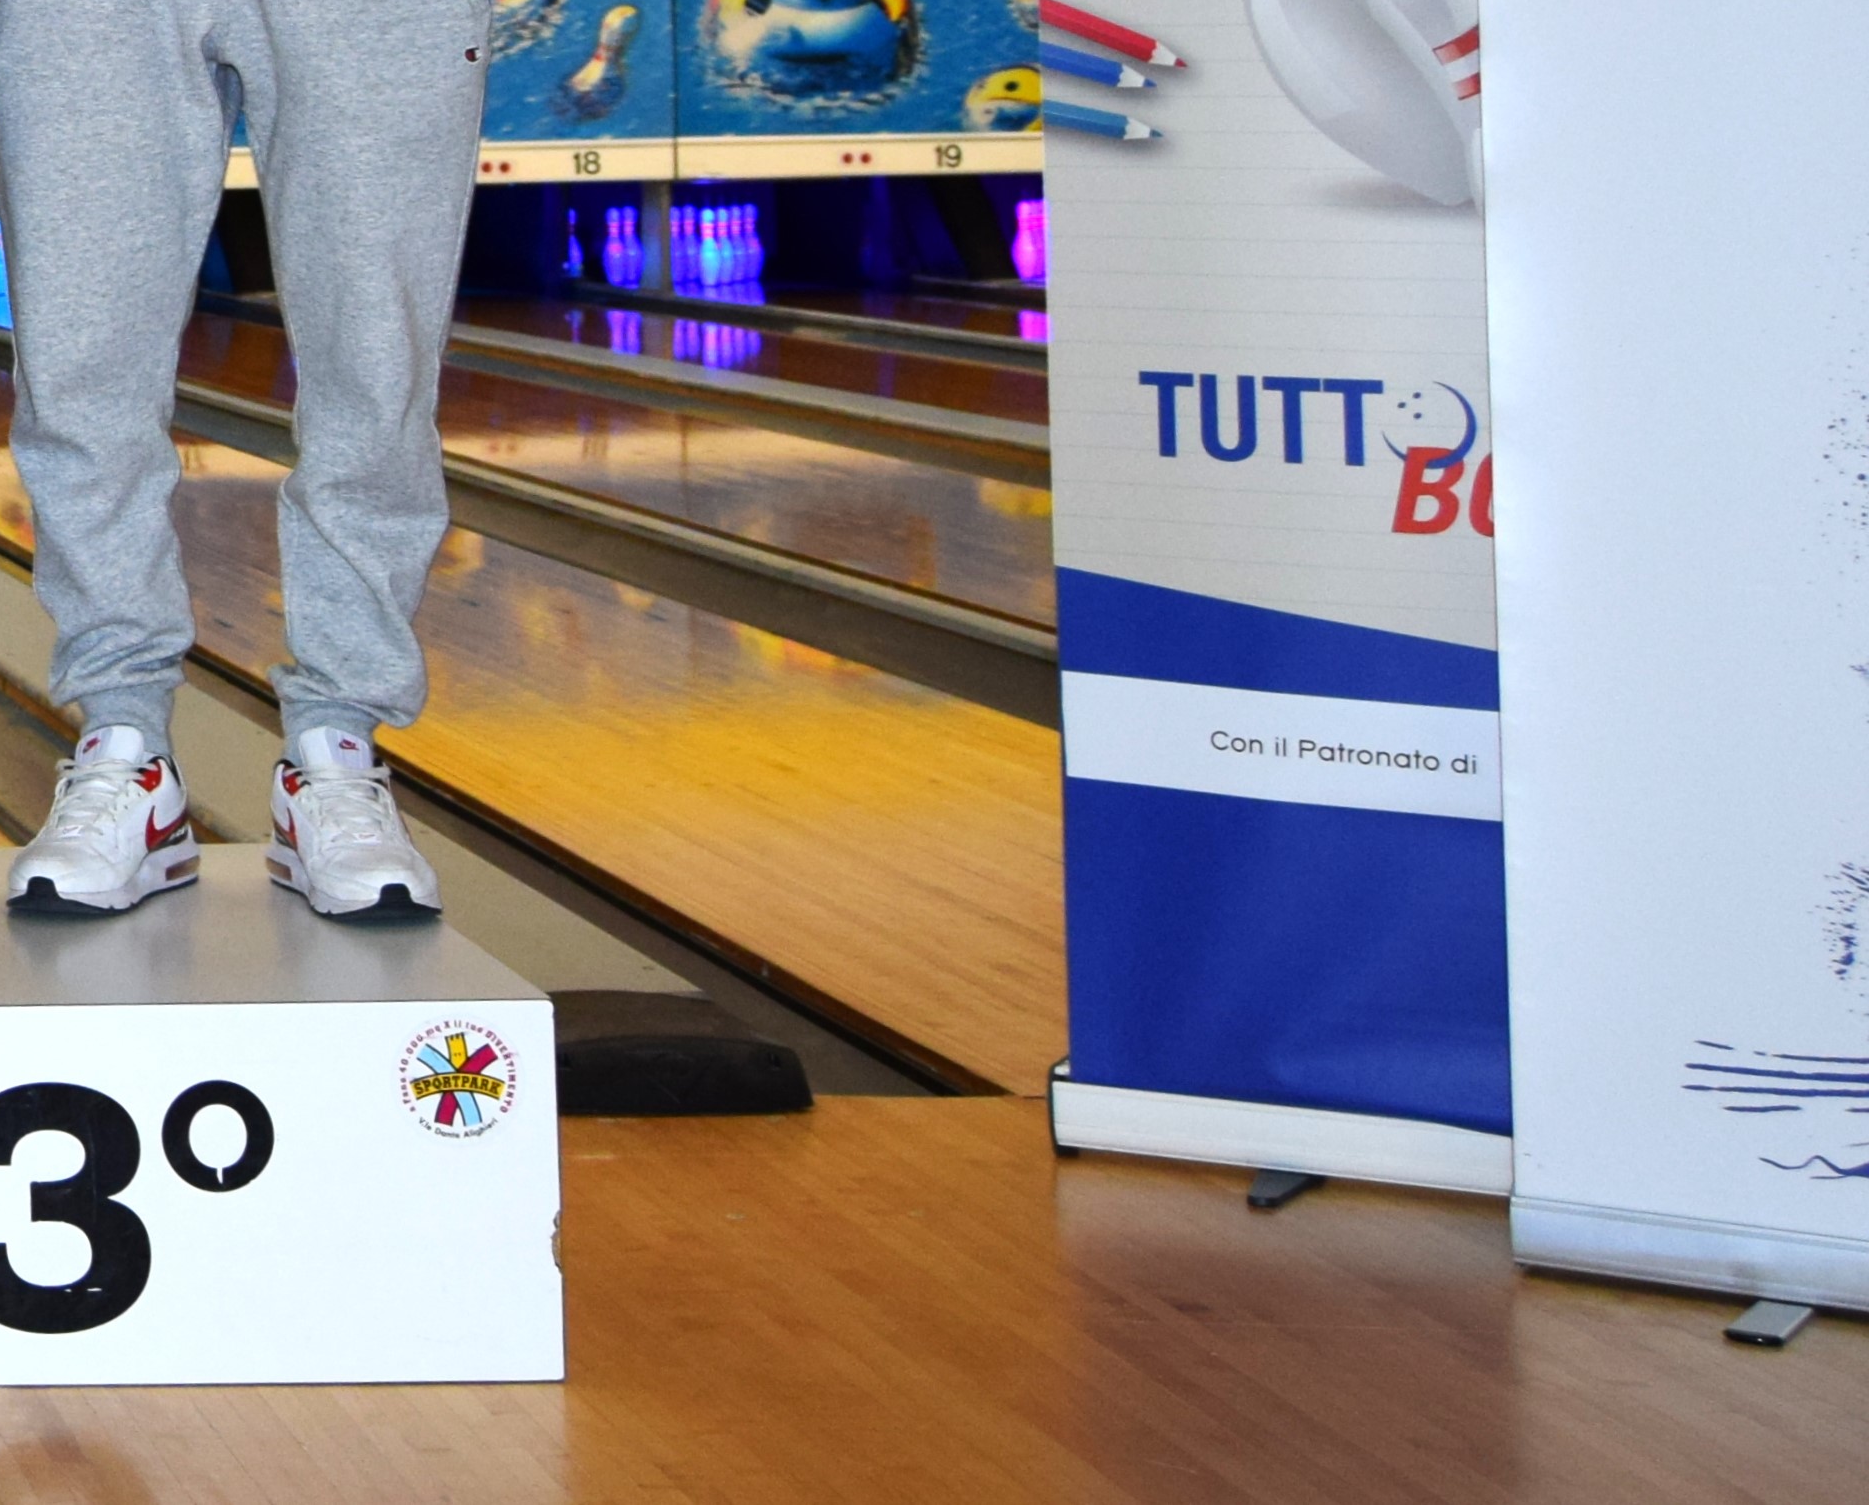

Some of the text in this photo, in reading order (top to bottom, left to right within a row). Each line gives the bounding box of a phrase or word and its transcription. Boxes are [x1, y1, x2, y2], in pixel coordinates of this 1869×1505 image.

[573, 151, 601, 175] 18
[935, 144, 962, 168] 19
[1210, 730, 1478, 775] Con il Patronato di
[413, 1075, 502, 1095] SPORTPARK
